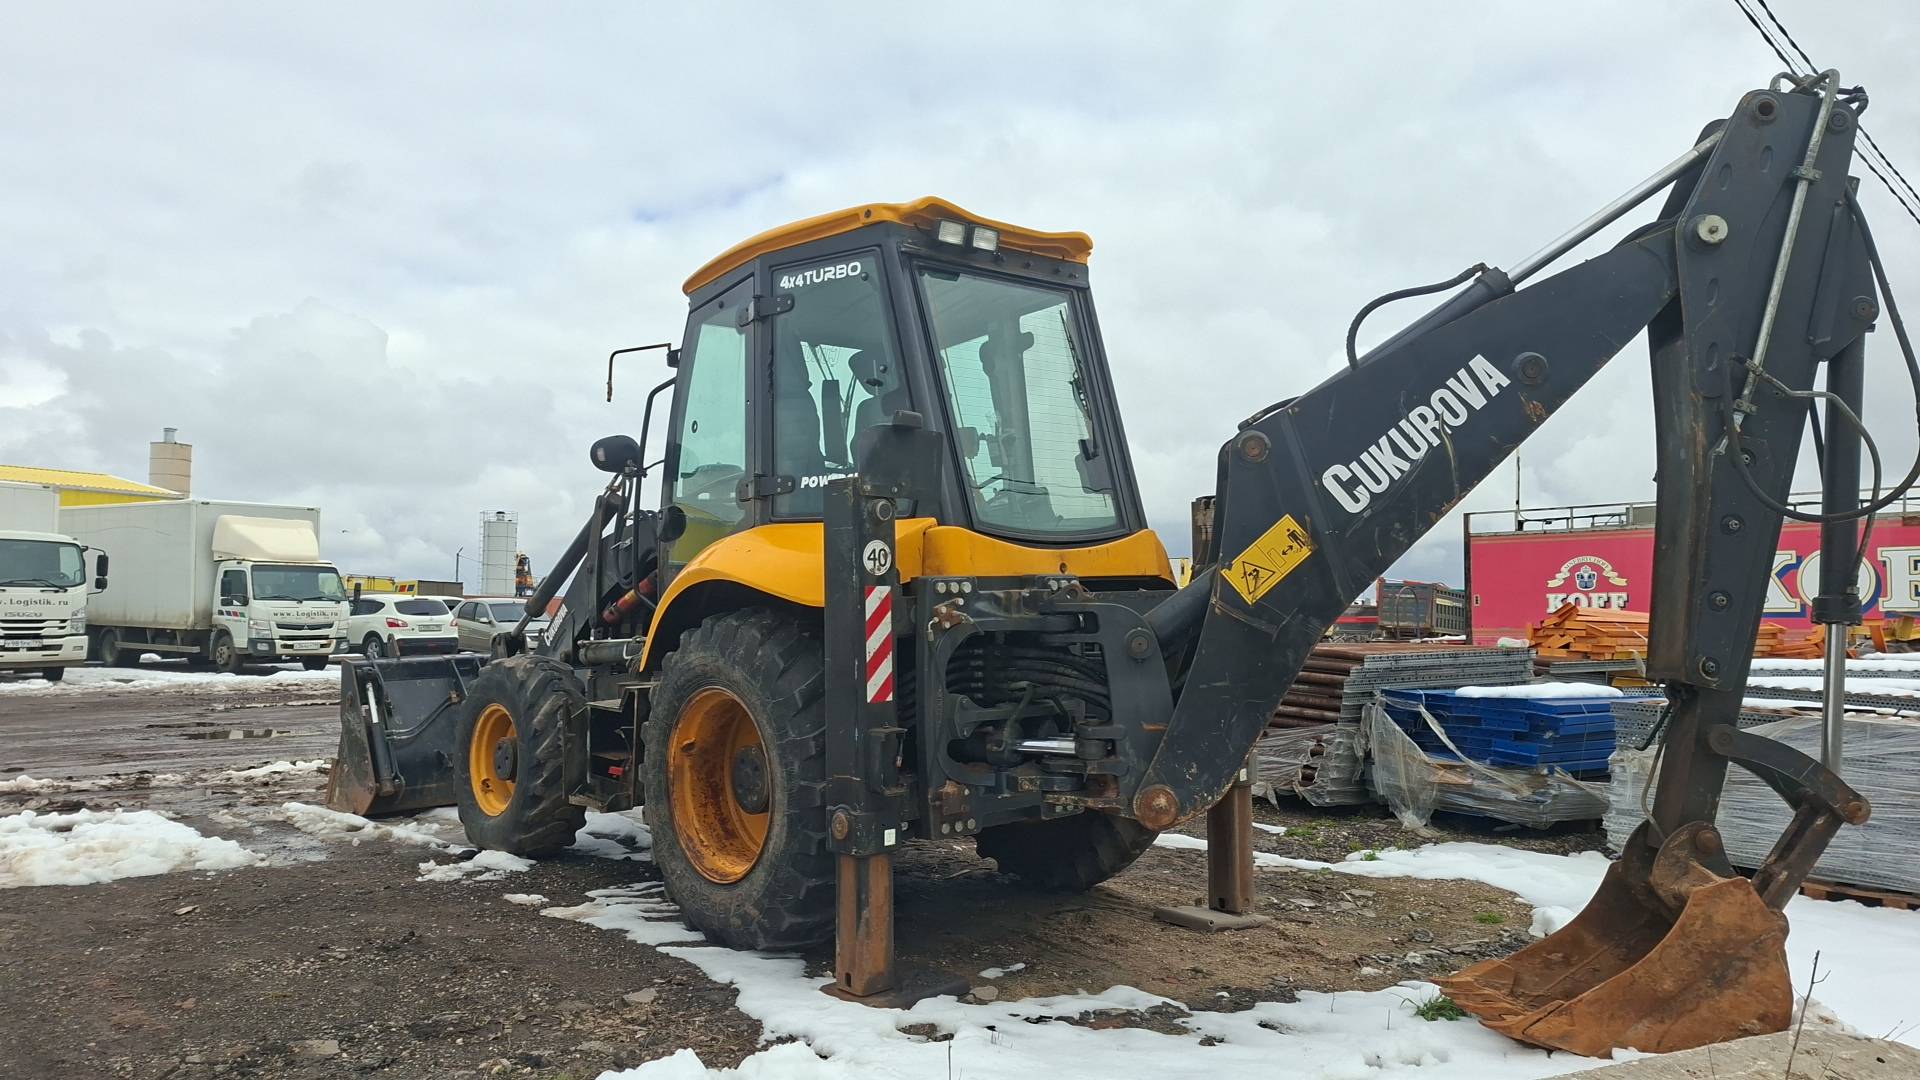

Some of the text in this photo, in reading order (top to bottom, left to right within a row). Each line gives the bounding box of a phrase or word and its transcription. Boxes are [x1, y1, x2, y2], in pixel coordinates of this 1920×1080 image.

[1322, 354, 1511, 514] CUKUROVA
[867, 548, 888, 569] 40
[1546, 592, 1628, 614] KOFF
